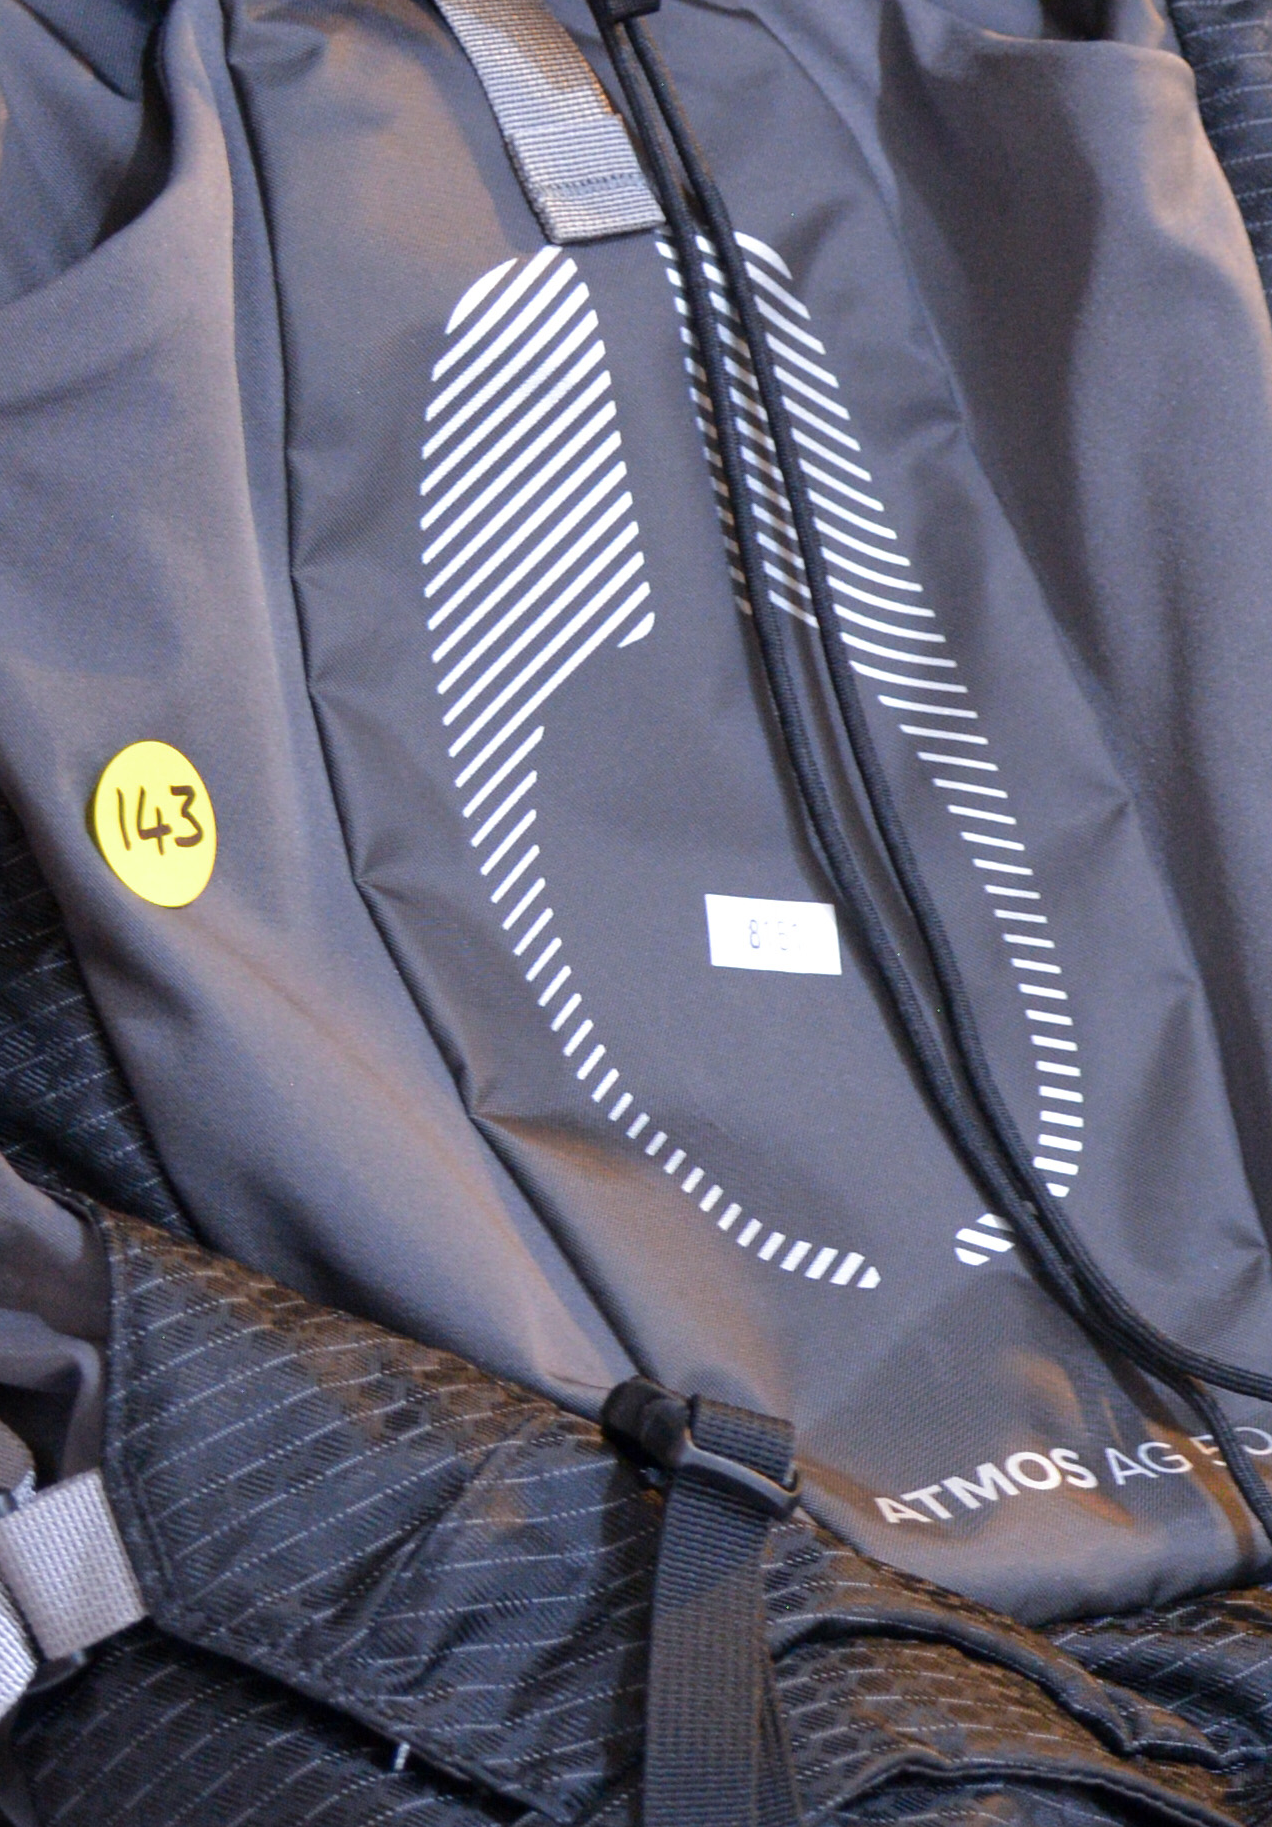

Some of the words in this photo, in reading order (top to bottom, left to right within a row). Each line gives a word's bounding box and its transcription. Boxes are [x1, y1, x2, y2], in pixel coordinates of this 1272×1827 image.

[116, 785, 205, 856] 143
[873, 1446, 1098, 1524] ATMOS
[1104, 1440, 1193, 1486] AG
